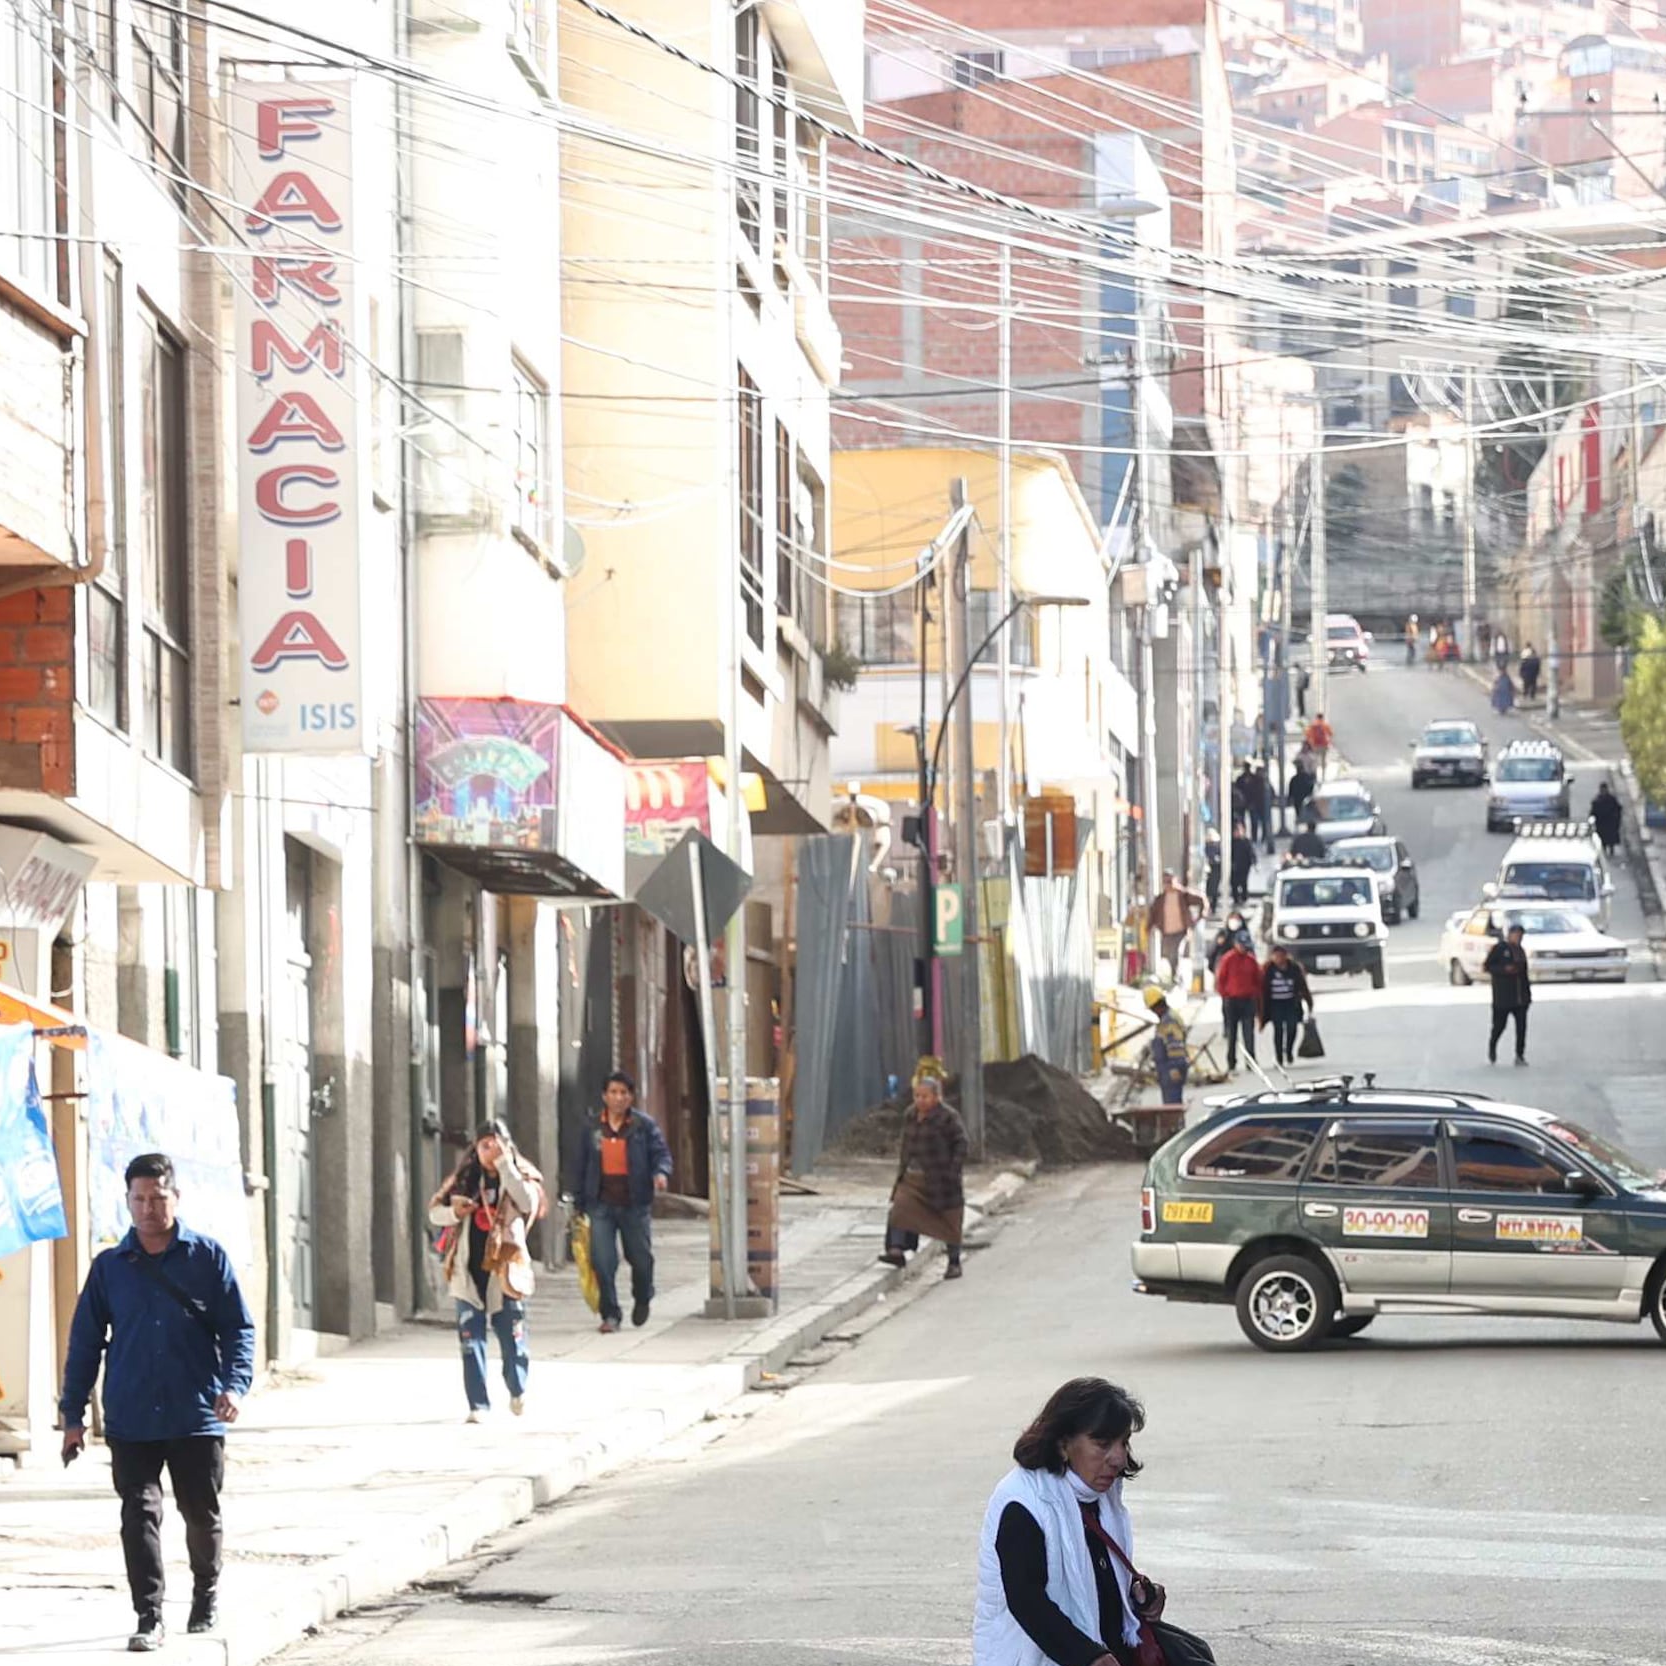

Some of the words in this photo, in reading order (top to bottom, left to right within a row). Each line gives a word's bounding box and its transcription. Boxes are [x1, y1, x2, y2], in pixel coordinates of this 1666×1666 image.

[243, 98, 350, 674] FARMACIA
[299, 703, 357, 731] ISIS
[936, 888, 960, 943] P
[1343, 1209, 1428, 1234] 30-90-90
